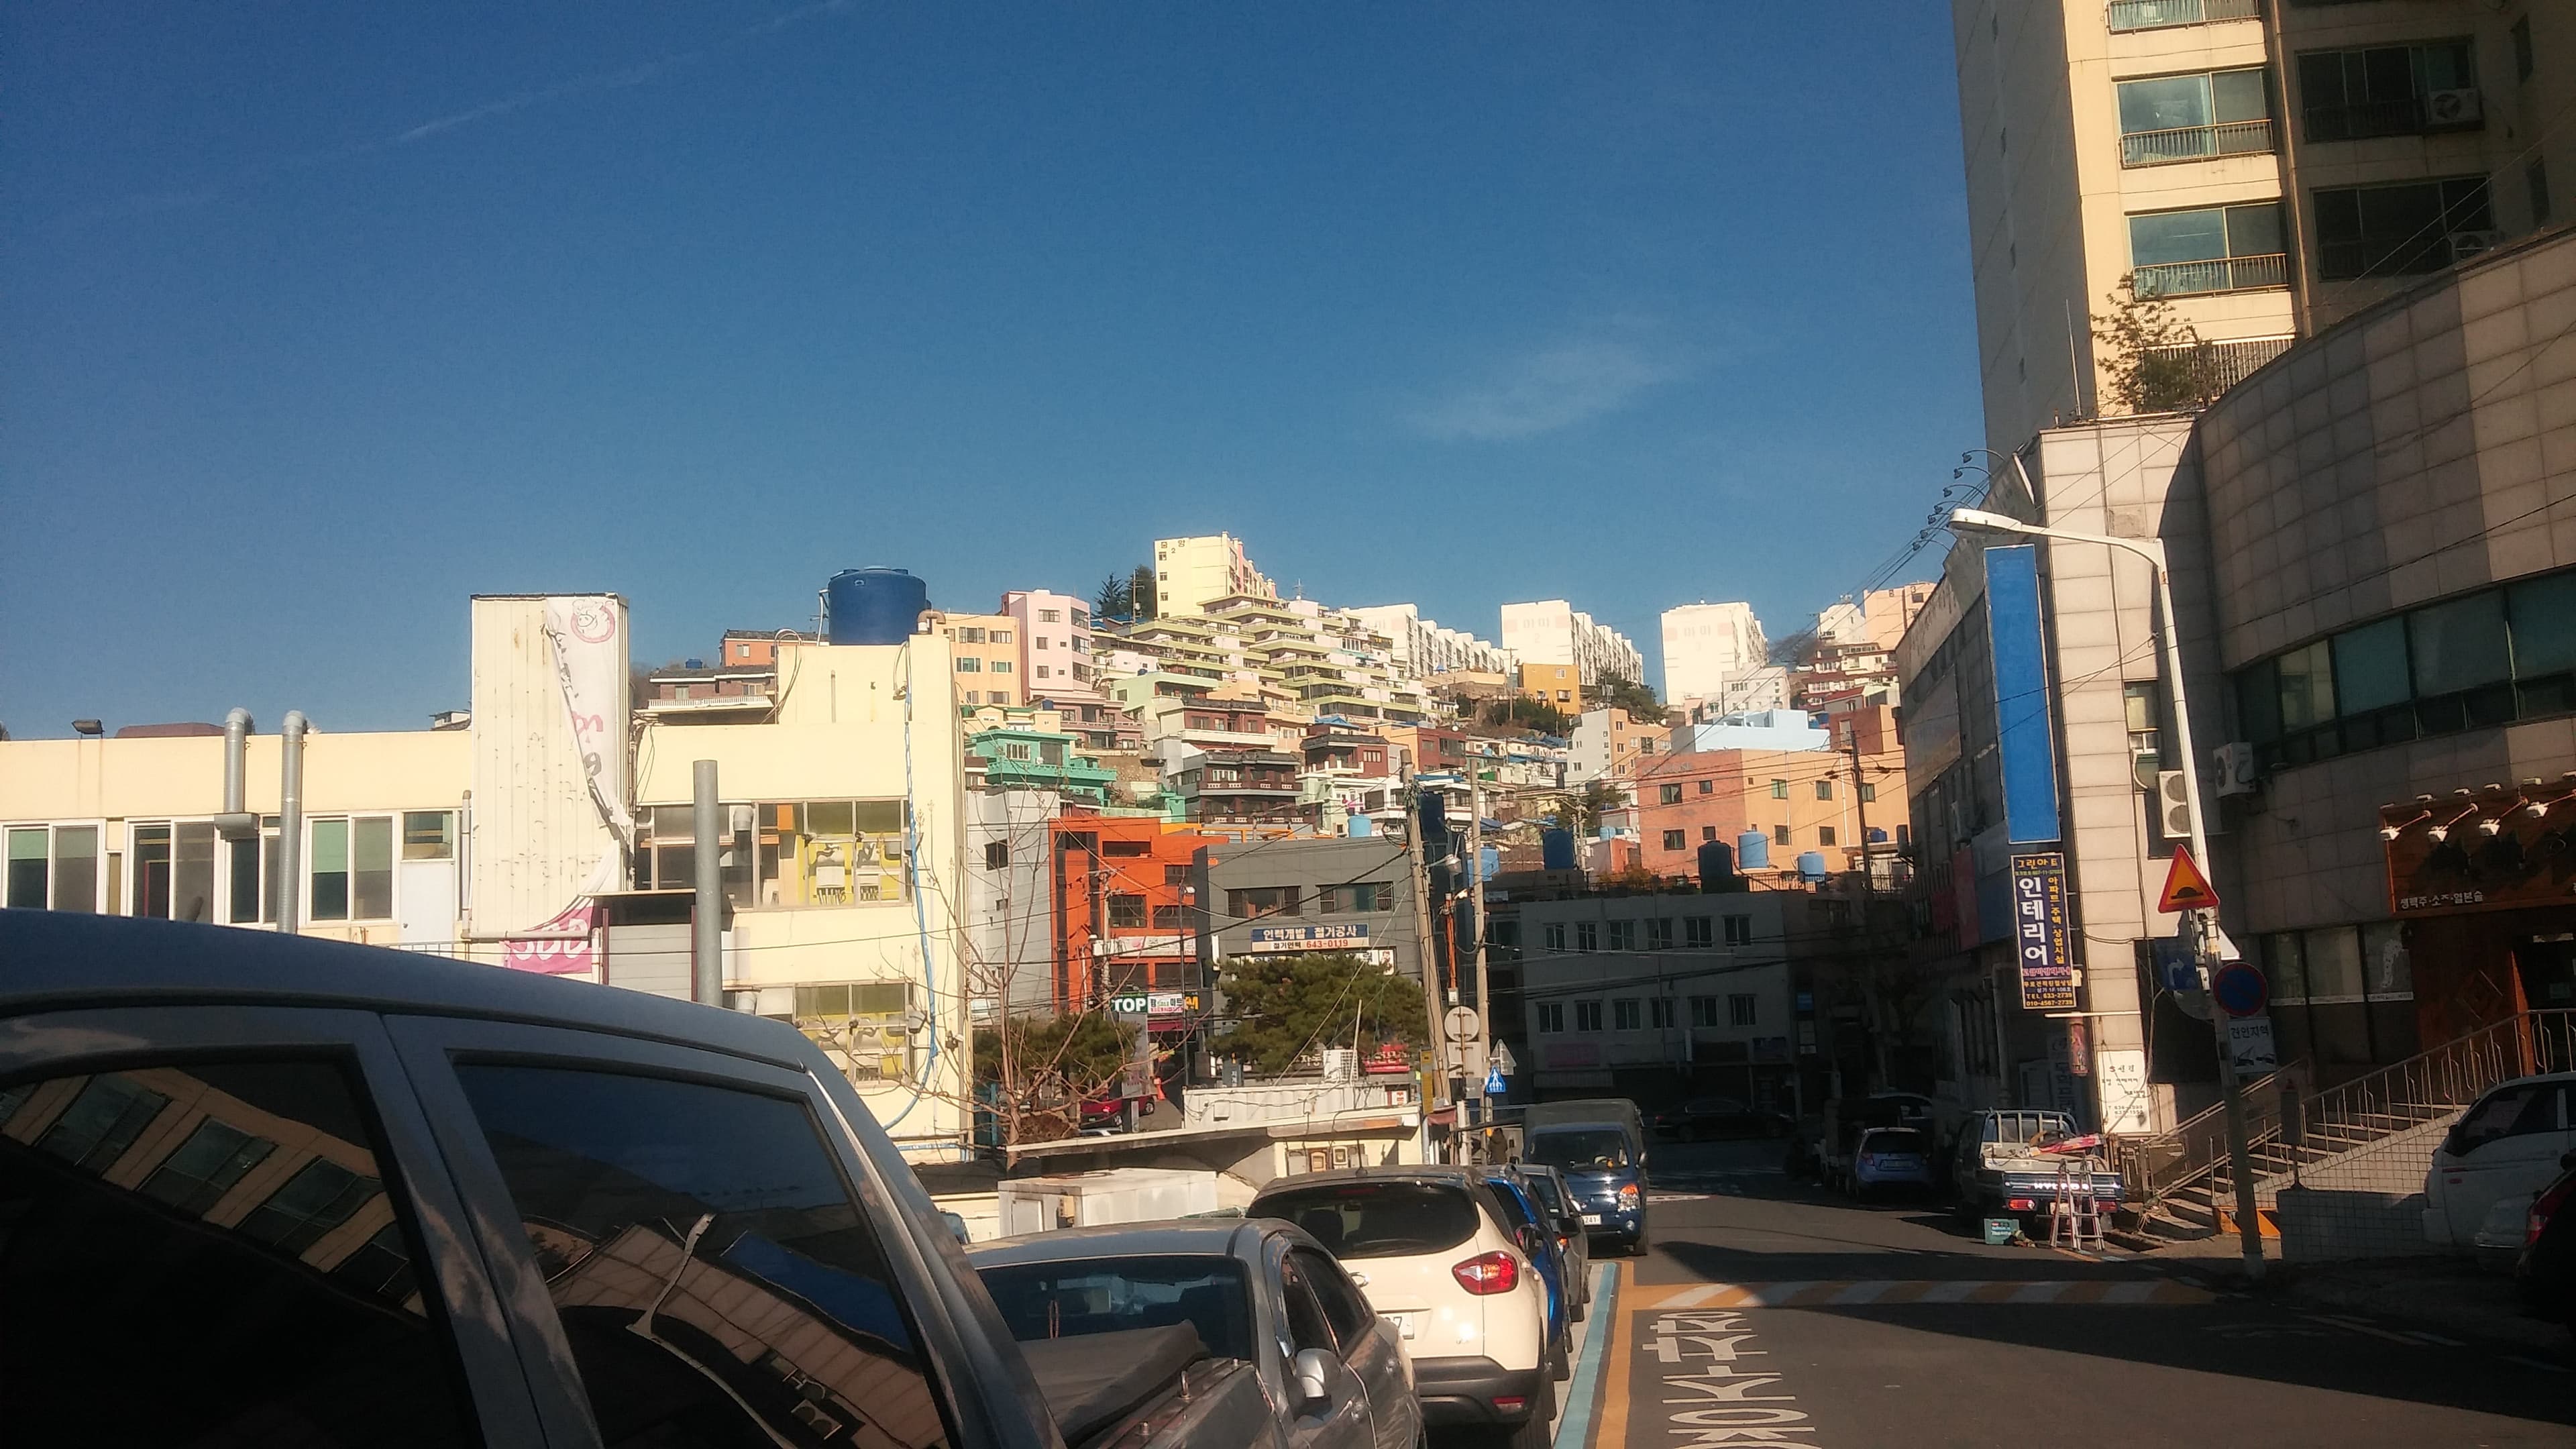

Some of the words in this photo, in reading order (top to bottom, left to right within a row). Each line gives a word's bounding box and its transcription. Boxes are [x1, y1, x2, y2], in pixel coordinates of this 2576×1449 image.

[2019, 877, 2049, 966] 인테리어
[1263, 928, 1306, 941] 인력개발
[1305, 939, 1348, 949] 643-0119
[1111, 998, 1146, 1012] TOP
[2231, 1024, 2269, 1039] 견인지역
